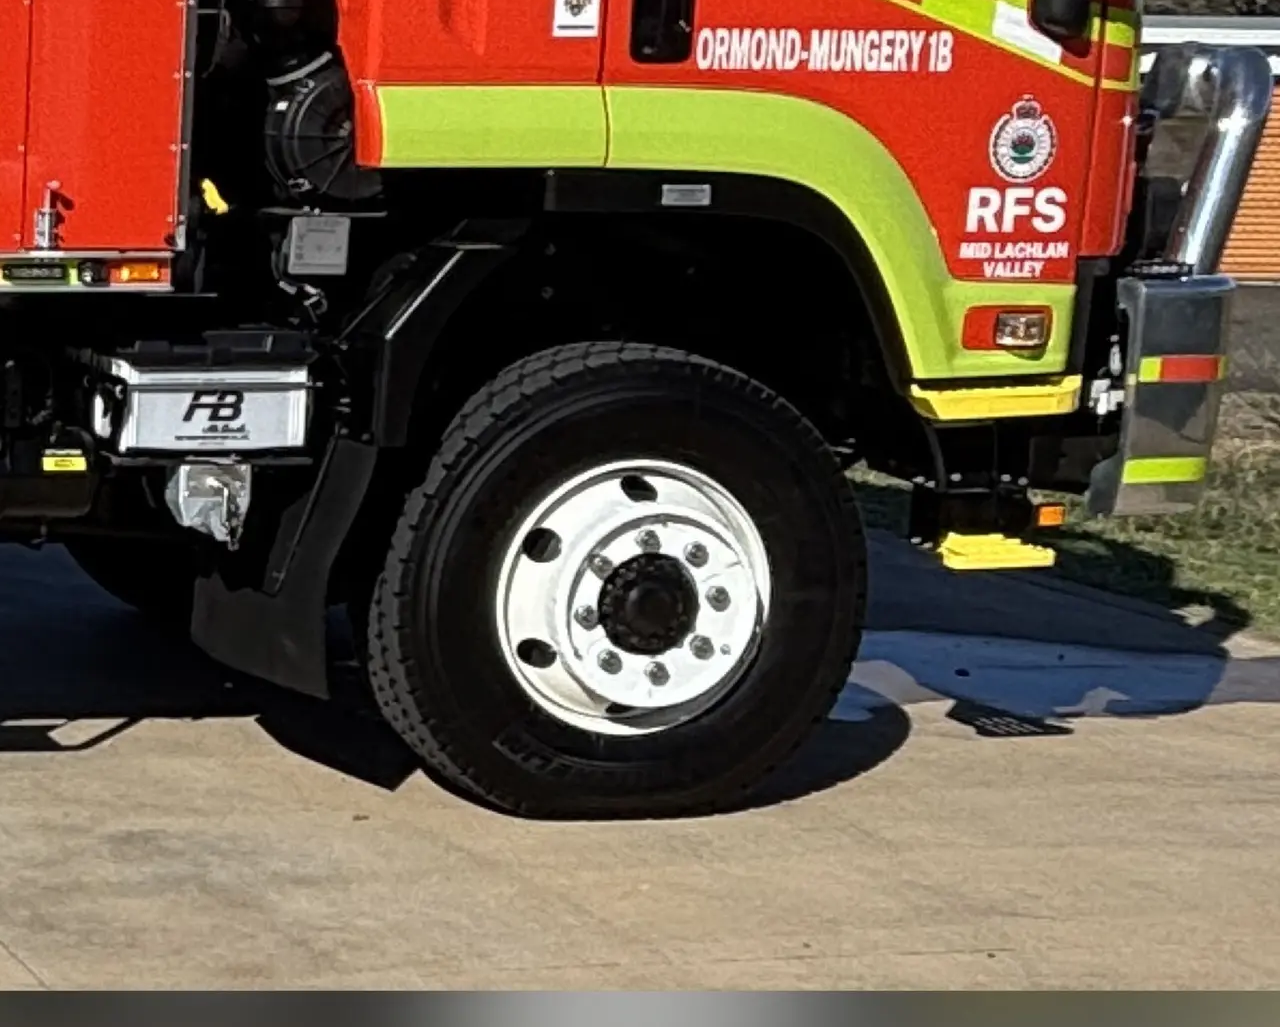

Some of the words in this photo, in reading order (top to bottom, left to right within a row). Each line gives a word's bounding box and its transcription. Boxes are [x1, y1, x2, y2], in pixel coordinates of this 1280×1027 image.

[696, 28, 926, 71] ORMOND-MUNGERY
[928, 31, 954, 72] 1B
[965, 187, 1068, 233] RFS
[959, 242, 991, 259] MID
[996, 242, 1070, 259] LACHLAN
[983, 261, 1044, 278] VALLEY
[182, 390, 244, 422] FB
